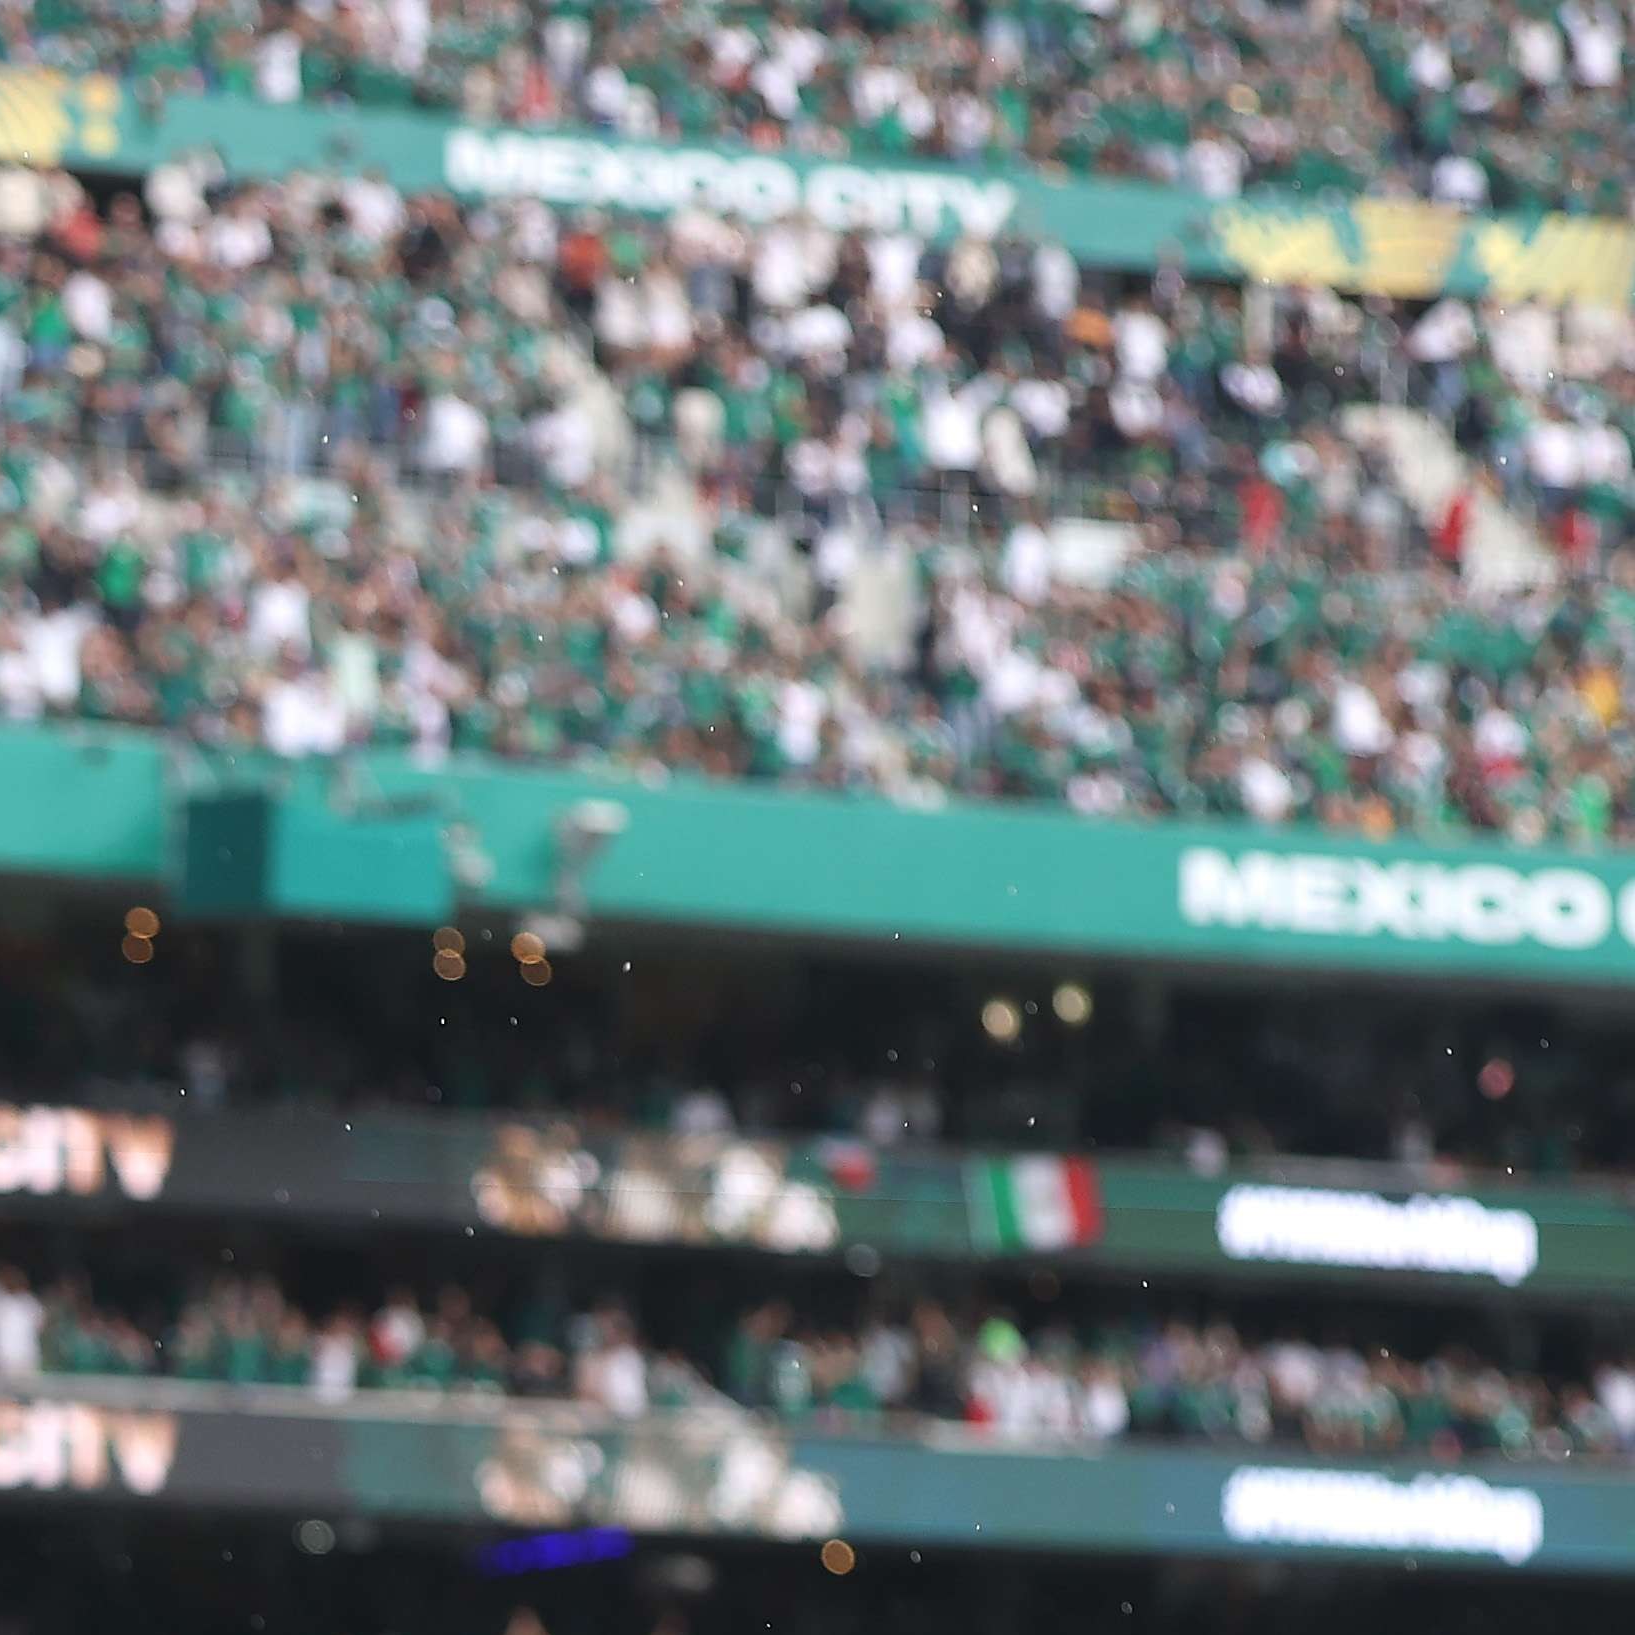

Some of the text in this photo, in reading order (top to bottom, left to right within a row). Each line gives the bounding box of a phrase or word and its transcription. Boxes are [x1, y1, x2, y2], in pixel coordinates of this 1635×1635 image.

[444, 129, 1017, 239] MEXICO CITY
[1178, 846, 1613, 951] MEXICO
